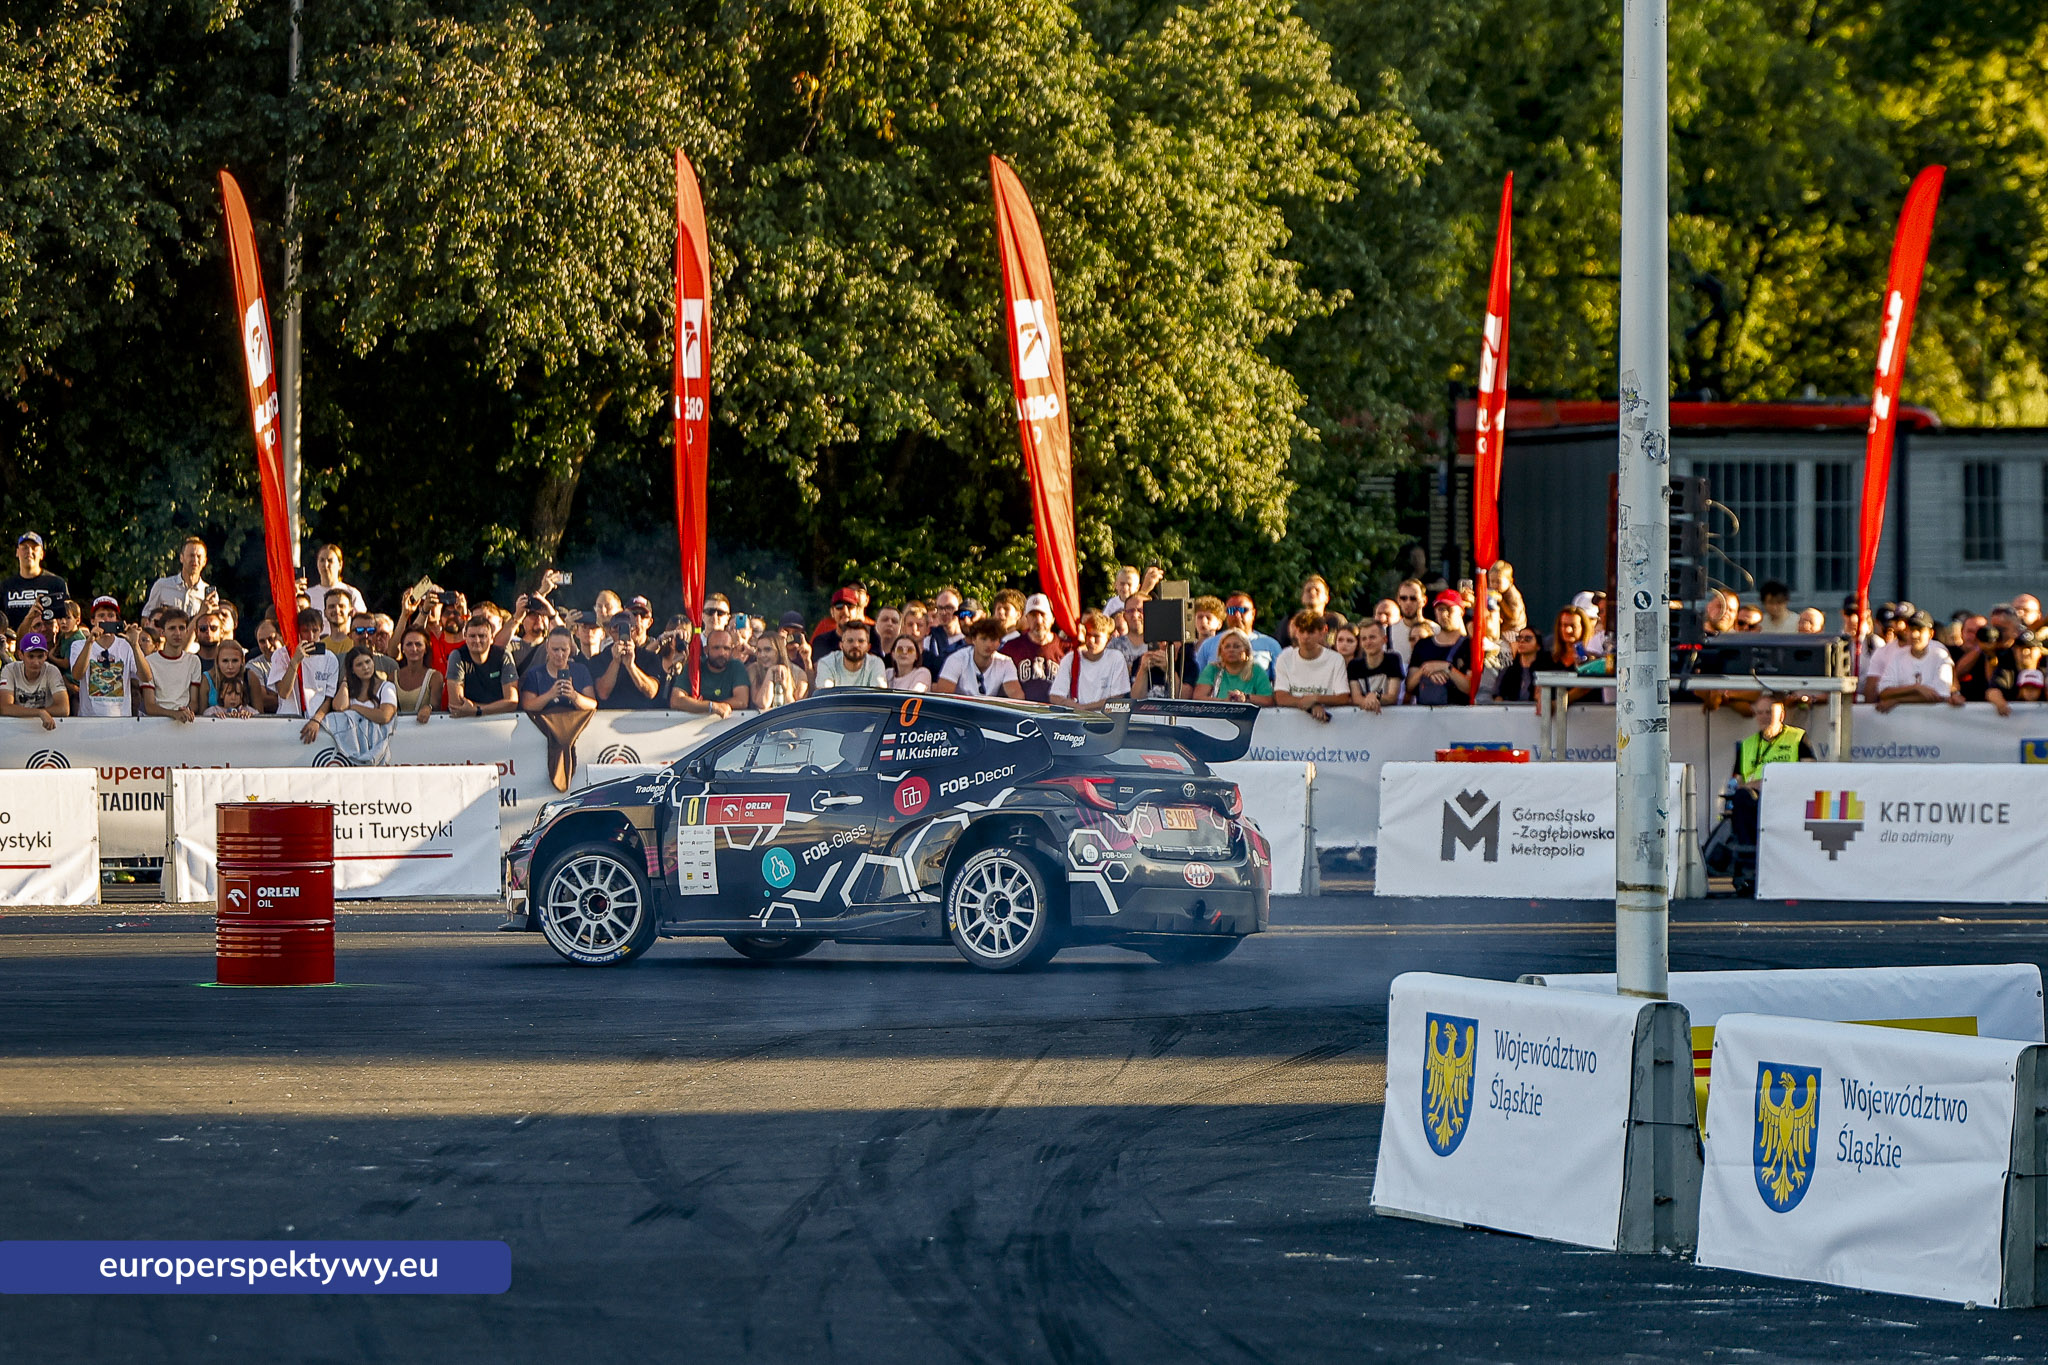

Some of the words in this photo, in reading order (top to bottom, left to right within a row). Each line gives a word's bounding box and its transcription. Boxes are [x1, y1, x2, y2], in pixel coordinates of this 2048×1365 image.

[900, 697, 923, 727] 0
[899, 730, 948, 744] T.Ociepa
[895, 746, 959, 761] M.Kuśnierz
[939, 764, 1017, 797] FOB-Decor
[332, 799, 412, 816] sterstwo
[687, 797, 700, 826] 0
[745, 802, 772, 810] ORLEN
[1880, 801, 2010, 824] KATOWICE
[1512, 807, 1595, 825] Górnośląsko
[359, 822, 364, 839] i
[369, 820, 453, 841] Turystyki
[1512, 826, 1615, 842] -Zagłębiowska
[1880, 830, 1898, 843] dla
[1902, 831, 1954, 846] odmiany
[802, 824, 867, 865] FOB-Glass
[1511, 844, 1585, 859] Metropolia
[257, 886, 300, 898] ORLEN
[257, 899, 274, 908] OIL
[1494, 1029, 1597, 1074] Województwo
[1490, 1072, 1543, 1121] Śląskie
[1840, 1077, 1968, 1124] Województwo
[1836, 1122, 1902, 1173] Śląskie
